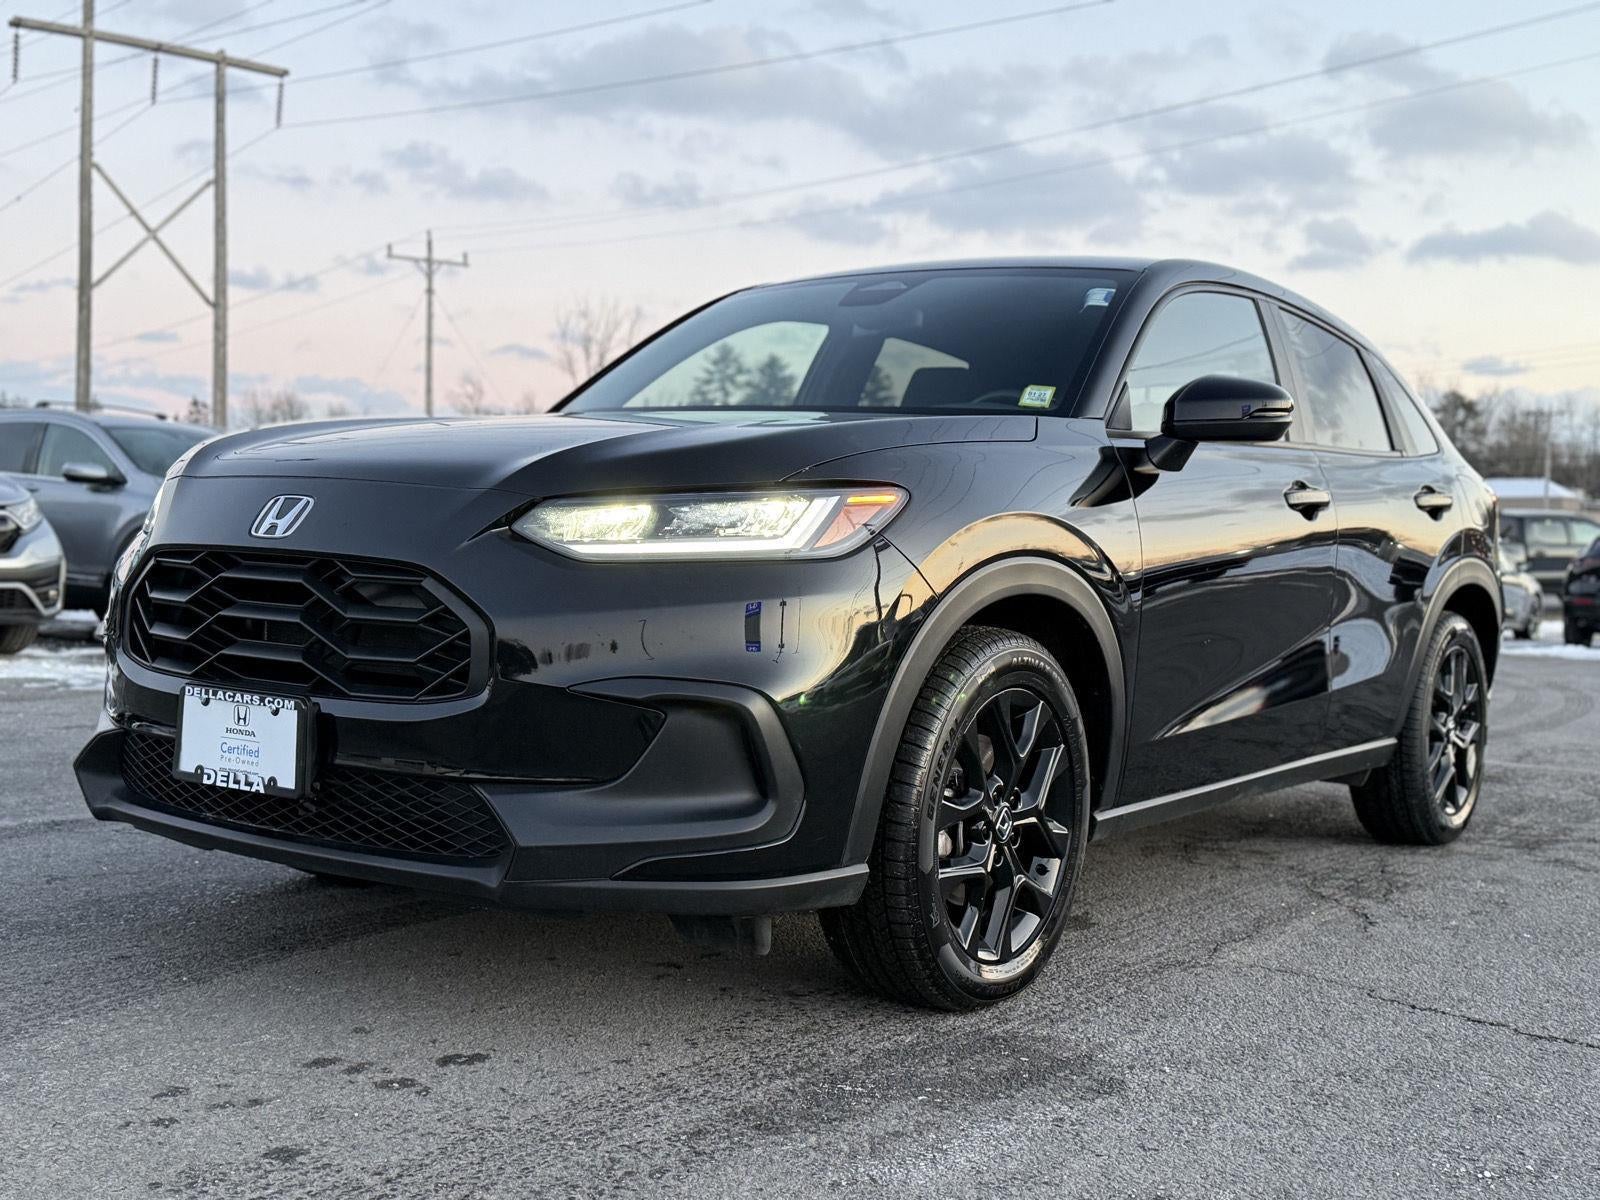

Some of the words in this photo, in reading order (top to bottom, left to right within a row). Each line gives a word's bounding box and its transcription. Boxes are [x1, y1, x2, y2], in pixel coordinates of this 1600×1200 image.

[185, 686, 295, 710] DELLACARS.COM
[225, 727, 256, 738] HONDA
[220, 741, 260, 758] Certified
[219, 754, 259, 767] Pre-Owned
[927, 718, 959, 821] GENERAL
[202, 768, 265, 793] DELLA
